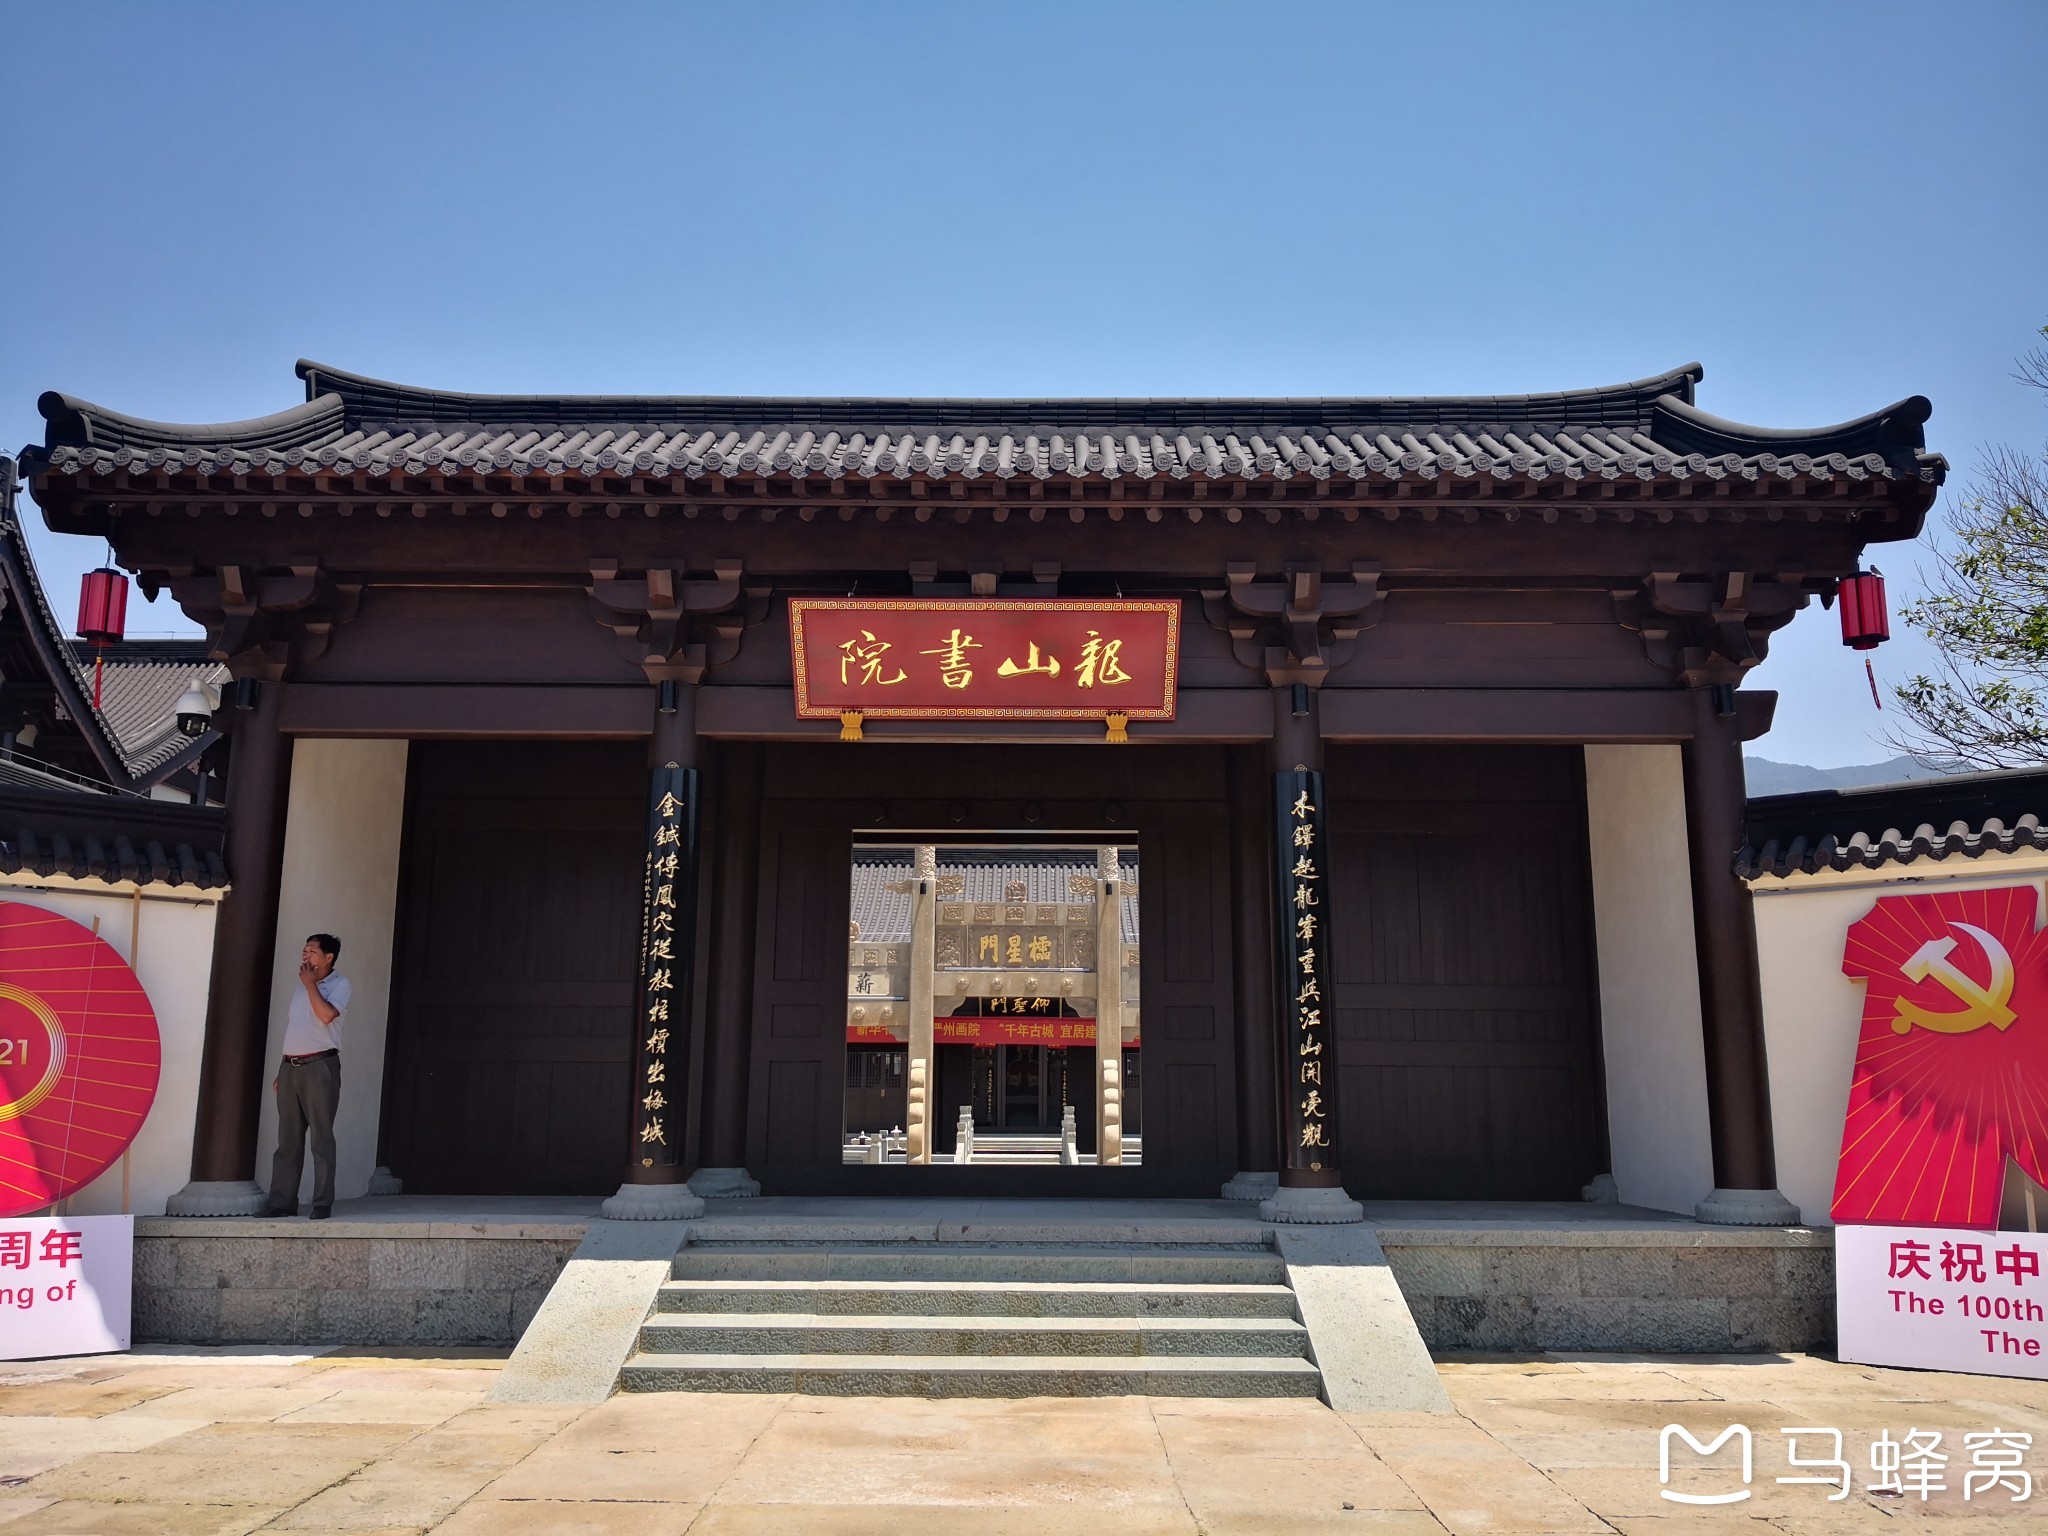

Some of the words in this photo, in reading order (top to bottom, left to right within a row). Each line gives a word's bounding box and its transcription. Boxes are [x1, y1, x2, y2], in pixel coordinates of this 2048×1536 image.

[1888, 1239, 2040, 1287] 庆祝中
[46, 1279, 76, 1302] of
[1888, 1290, 1945, 1315] The
[1957, 1294, 2044, 1322] 100th
[1980, 1329, 2041, 1357] The
